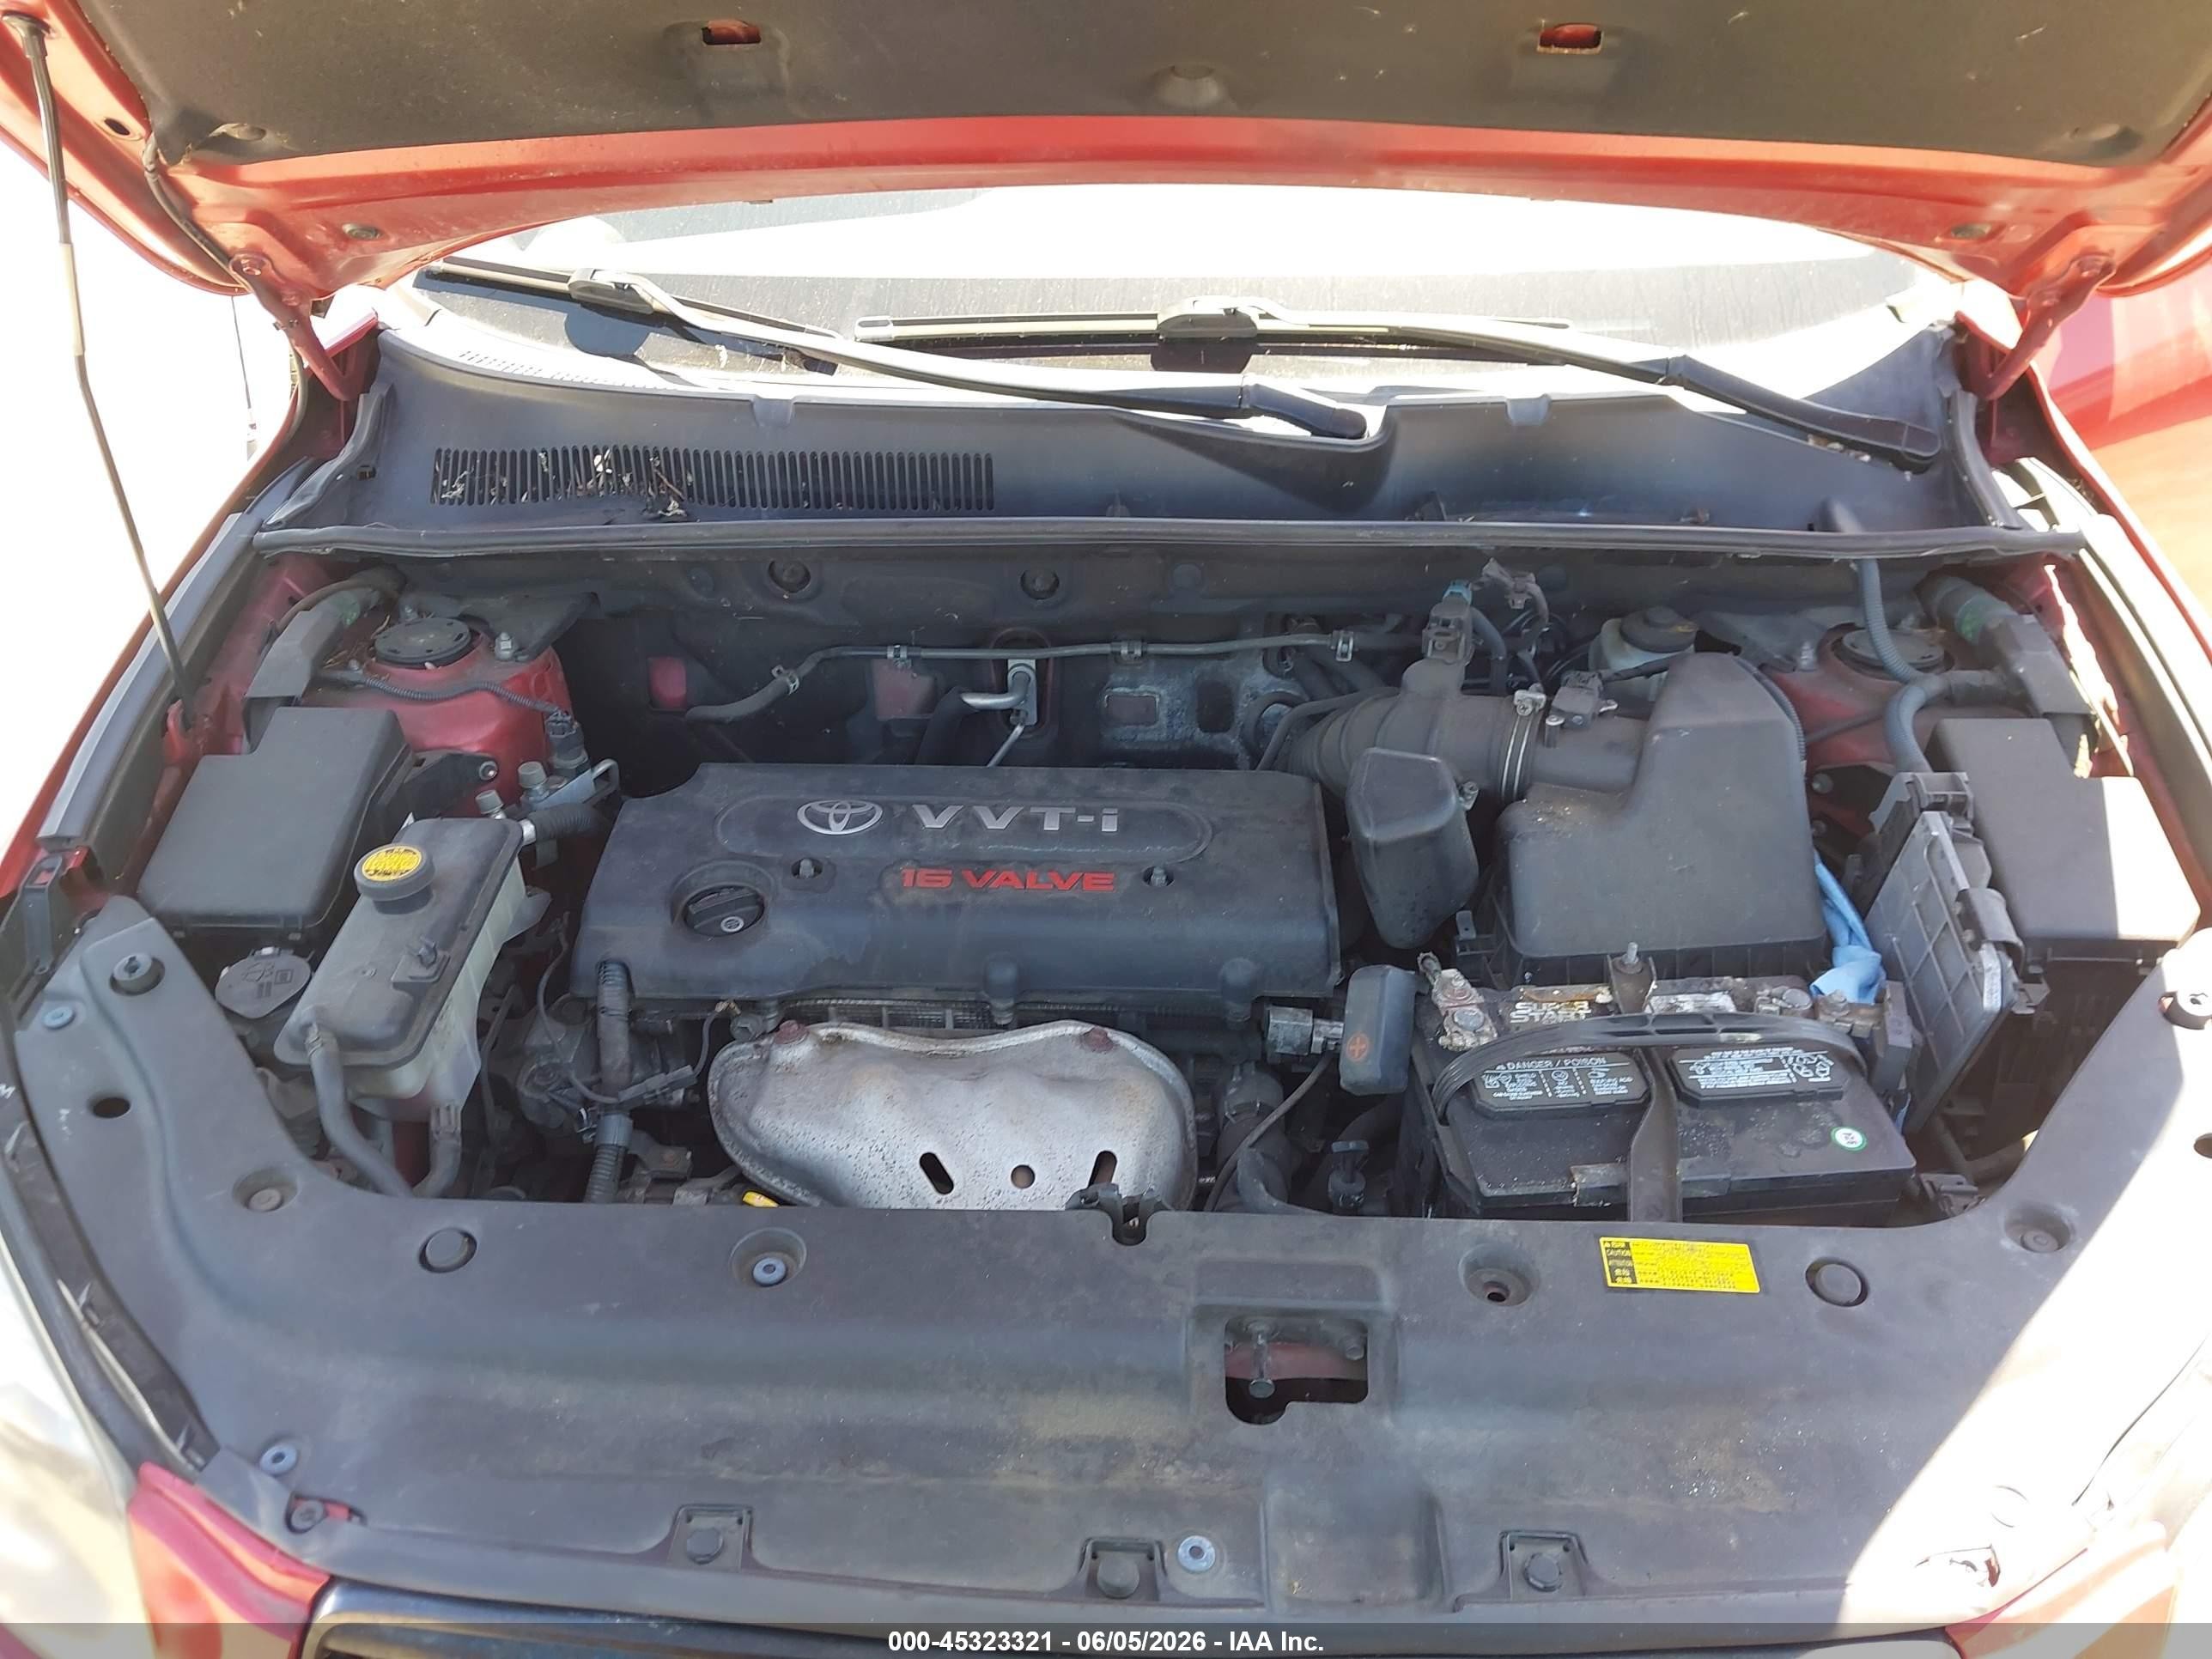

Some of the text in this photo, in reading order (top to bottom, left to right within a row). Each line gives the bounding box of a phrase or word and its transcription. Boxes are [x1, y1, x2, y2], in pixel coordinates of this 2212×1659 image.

[912, 804, 1118, 832] VVT-i
[901, 868, 1115, 891] 16 VALVE
[1510, 1009, 1592, 1024] START
